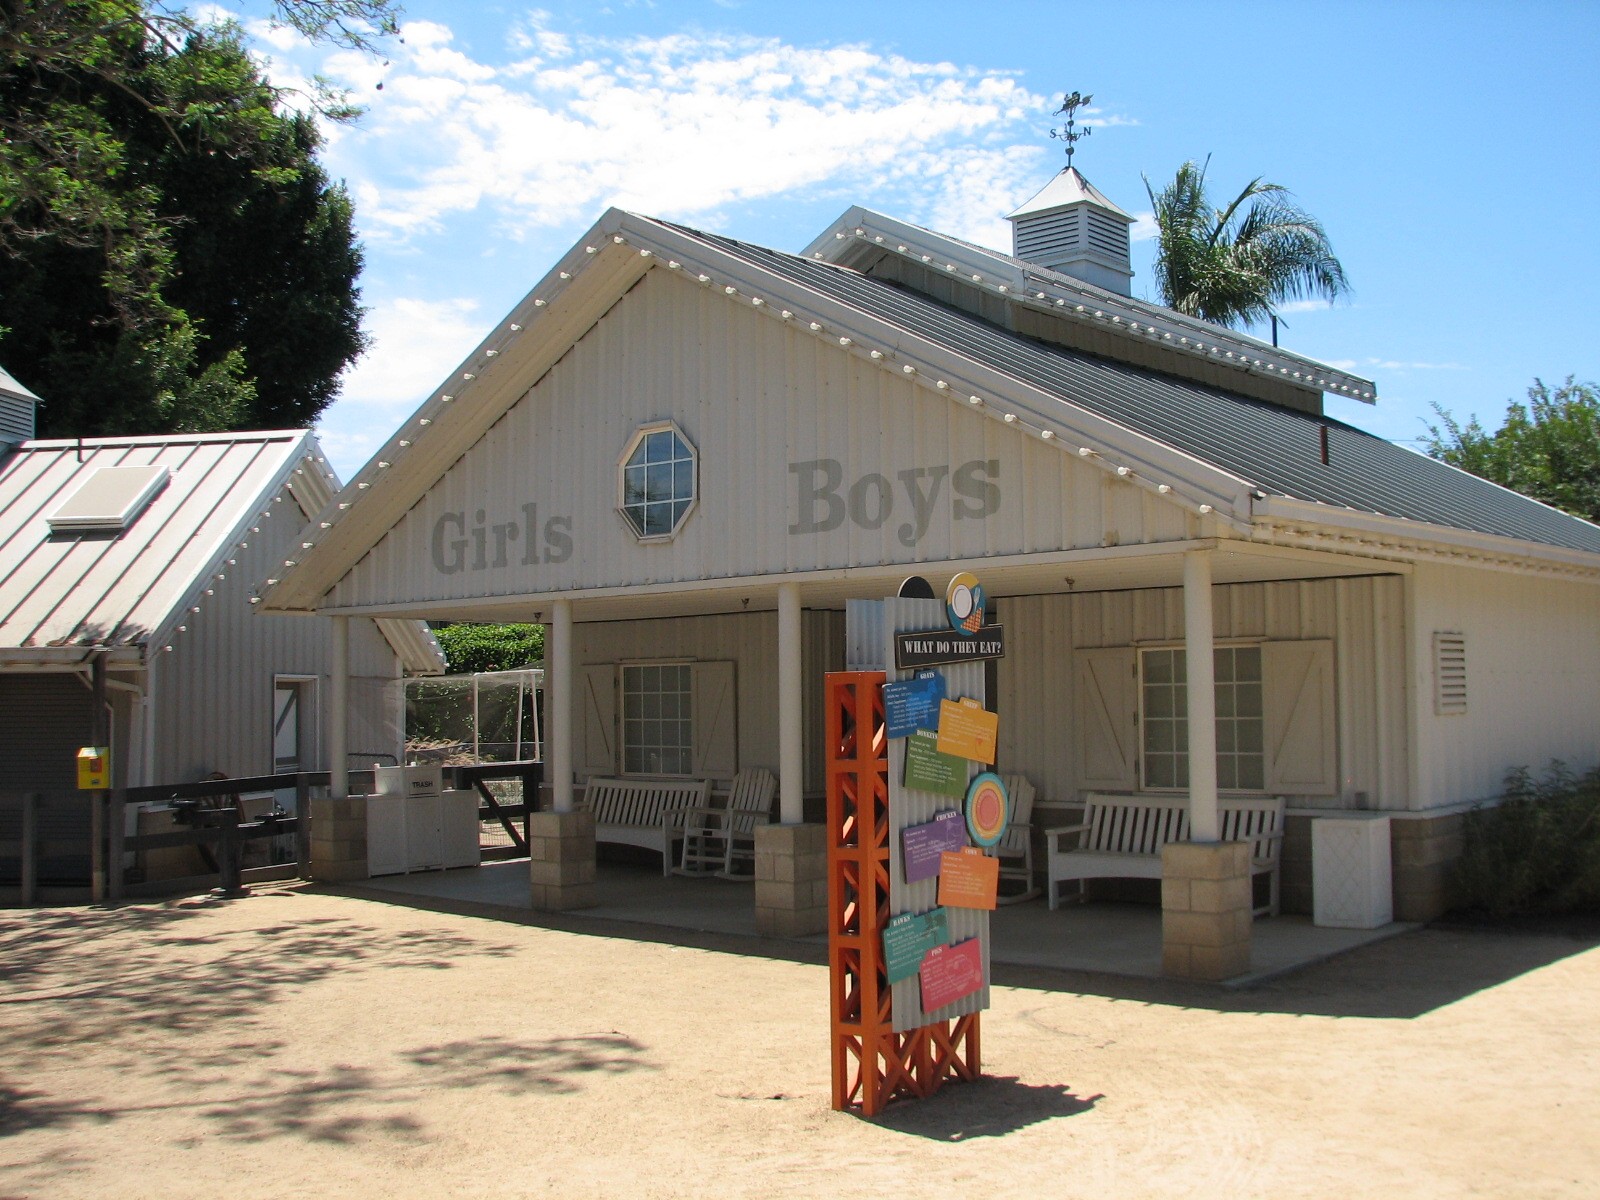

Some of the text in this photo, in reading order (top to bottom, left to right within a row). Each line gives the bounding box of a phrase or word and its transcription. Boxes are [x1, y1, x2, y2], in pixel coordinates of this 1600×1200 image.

[1049, 128, 1056, 138] S
[1083, 126, 1092, 136] N
[788, 458, 1000, 546] Boys
[431, 502, 574, 575] Girls
[904, 640, 1002, 654] WHAT DO THEY EAT?
[920, 672, 935, 680] GOATS
[936, 811, 957, 822] CHICKEN
